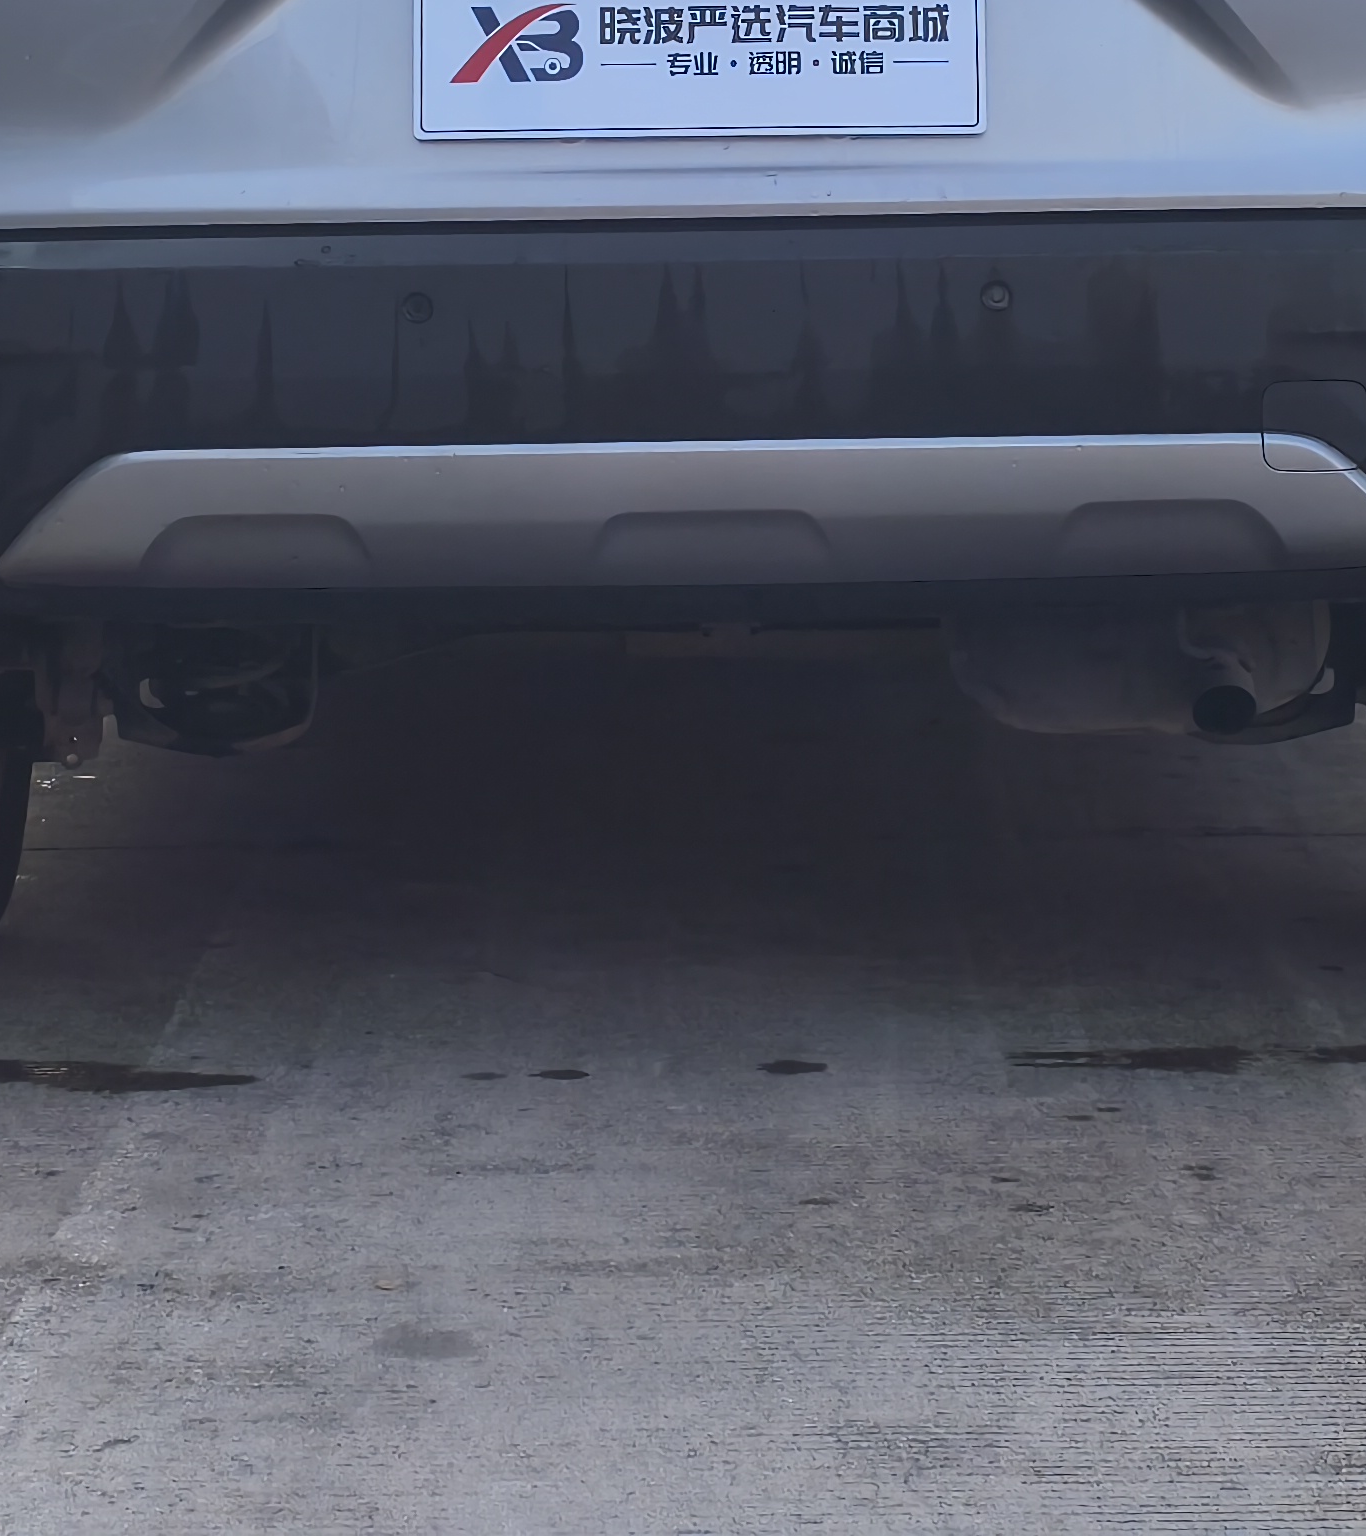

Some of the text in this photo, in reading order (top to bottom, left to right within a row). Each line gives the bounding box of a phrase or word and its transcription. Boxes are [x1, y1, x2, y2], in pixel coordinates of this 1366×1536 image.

[599, 3, 951, 47] 晓波严选汽车商城
